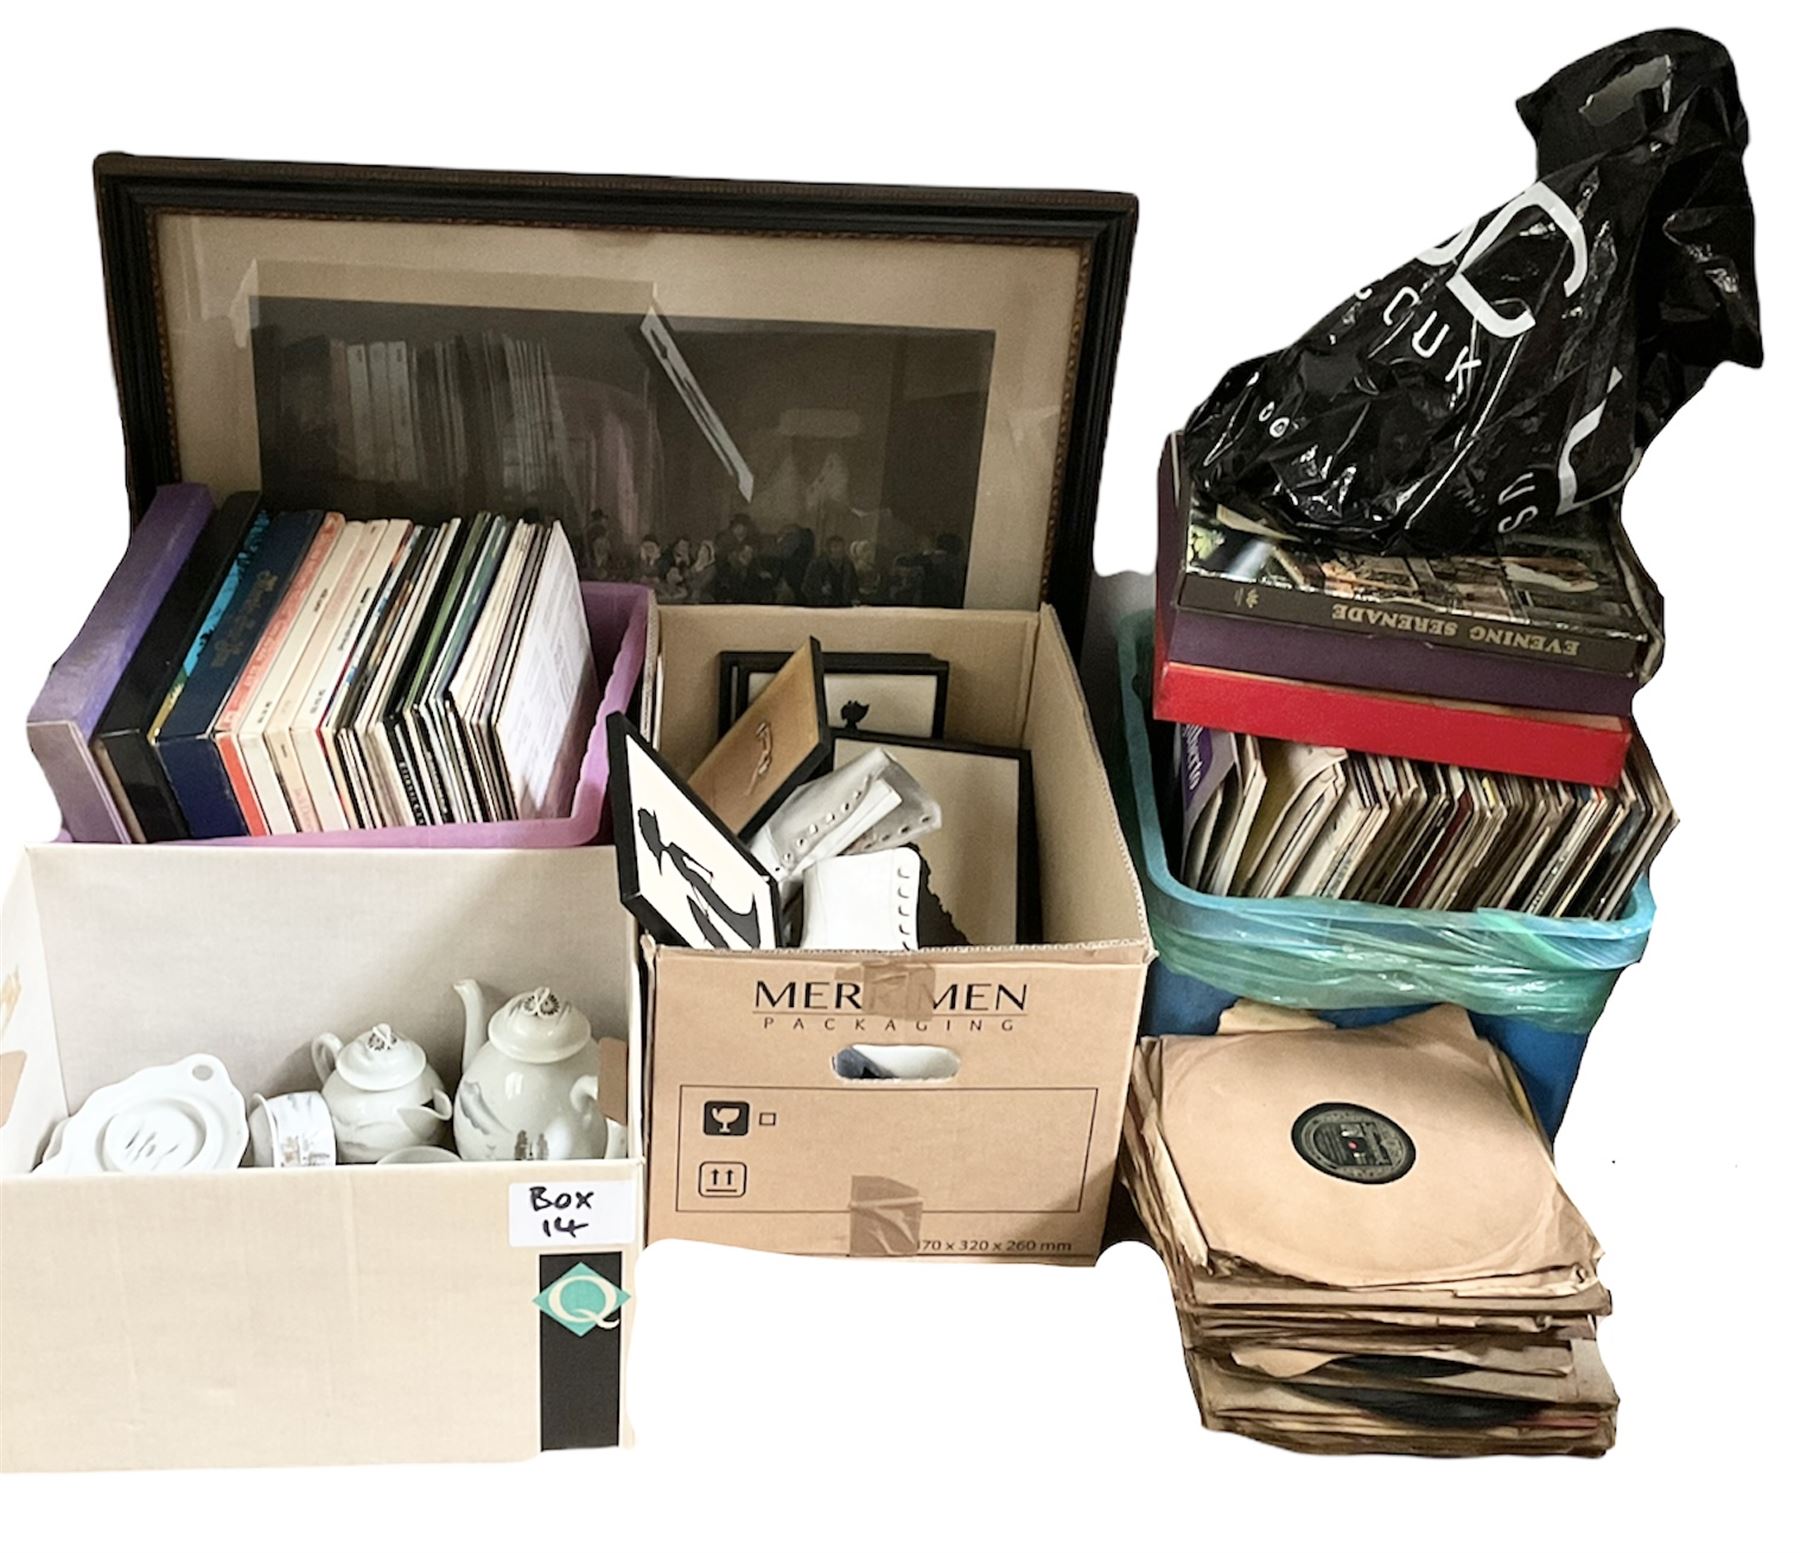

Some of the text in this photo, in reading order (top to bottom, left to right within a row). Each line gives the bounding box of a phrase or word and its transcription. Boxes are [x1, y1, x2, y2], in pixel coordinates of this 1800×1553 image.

[1331, 603, 1580, 656] EVENING SERENADE
[755, 980, 1028, 1011] MERMEN
[763, 1017, 1014, 1032] PACKAGING
[542, 1217, 589, 1238] 14
[945, 1242, 955, 1250] x
[961, 1240, 989, 1251] 320
[993, 1242, 1003, 1250] x
[1006, 1240, 1036, 1251] 260
[1040, 1241, 1072, 1251] mm
[548, 1275, 620, 1330] Q
